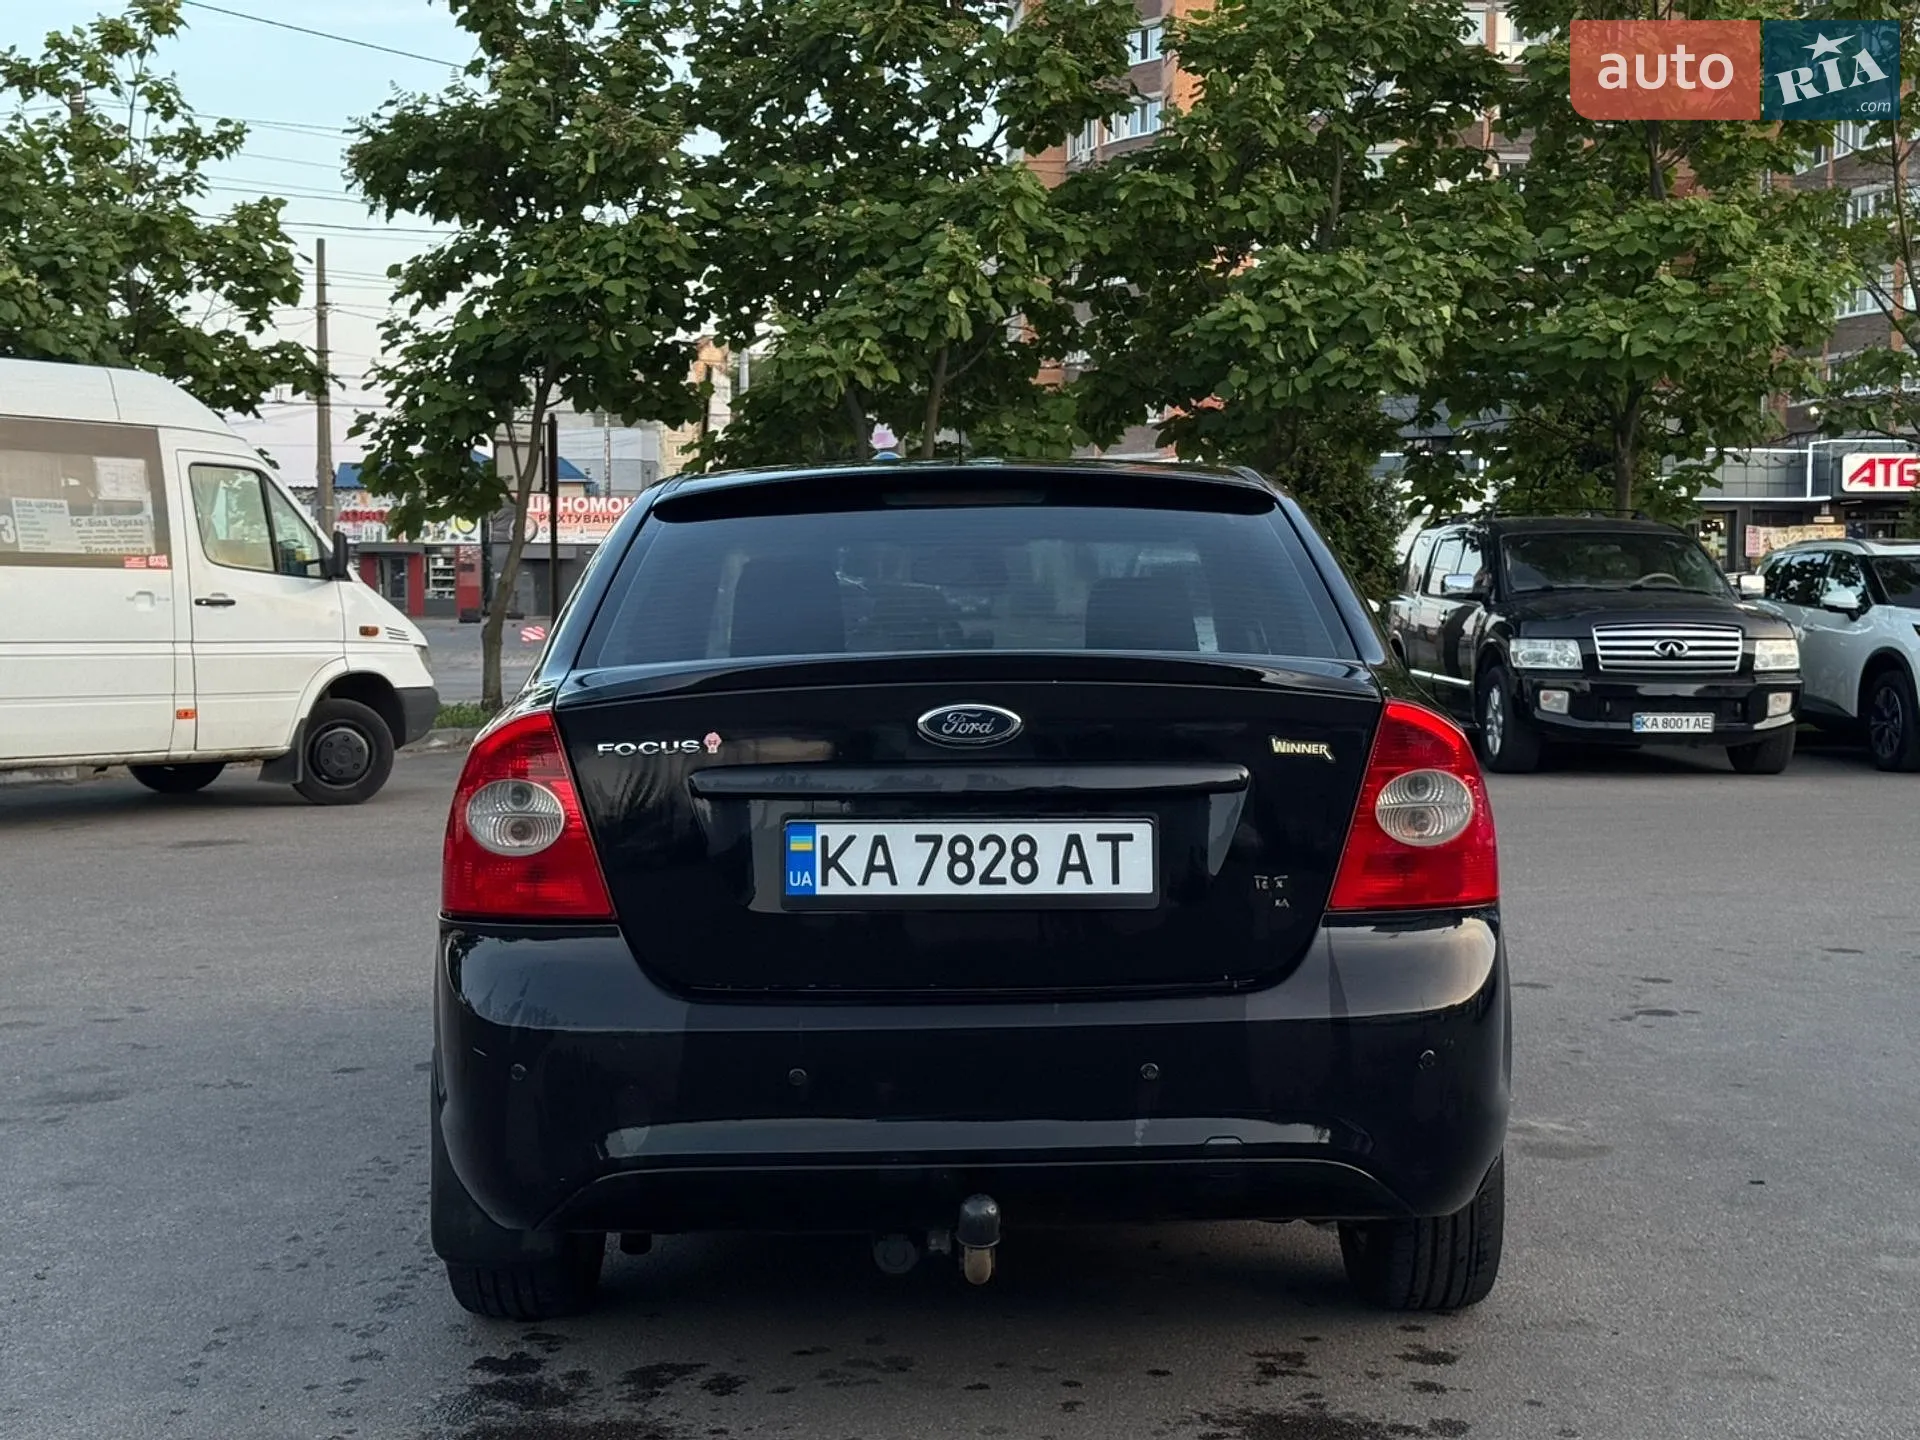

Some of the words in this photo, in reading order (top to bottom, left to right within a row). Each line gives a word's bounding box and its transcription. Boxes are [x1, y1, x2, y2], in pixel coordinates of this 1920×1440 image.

[942, 711, 996, 734] Ford
[1642, 717, 1659, 729] KA
[1661, 717, 1690, 729] 8001
[597, 740, 701, 756] FOCUS
[820, 834, 899, 886] KA
[914, 834, 1039, 886] 7828
[1056, 833, 1135, 886] AT
[789, 872, 813, 887] UA
